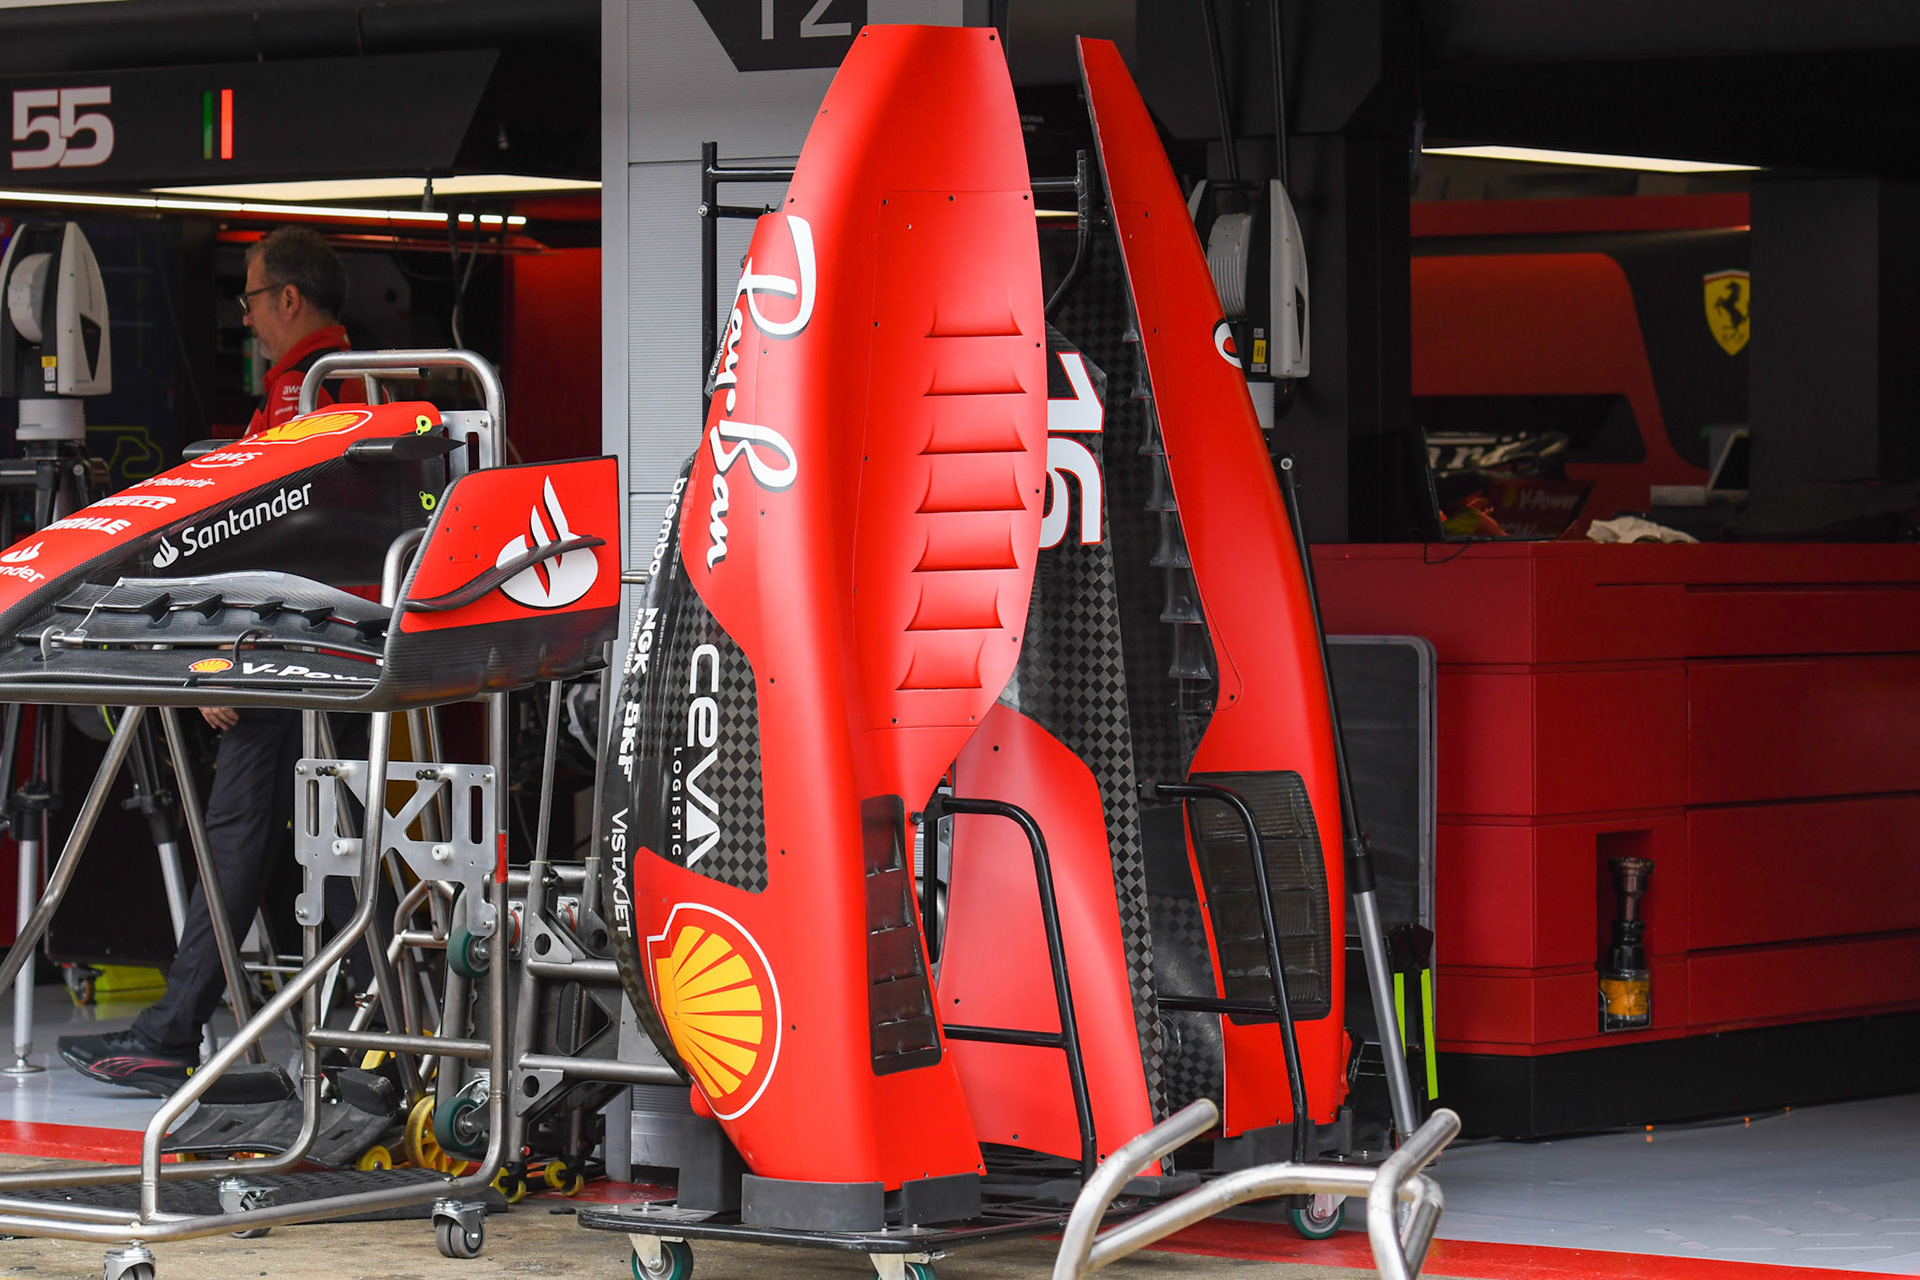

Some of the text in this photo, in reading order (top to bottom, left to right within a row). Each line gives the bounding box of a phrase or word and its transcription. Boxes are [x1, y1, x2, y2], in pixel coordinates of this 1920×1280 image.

[11, 86, 115, 169] 55
[282, 385, 301, 396] aw
[707, 215, 817, 570] Ray-Ban
[41, 517, 132, 535] MAHLE
[181, 483, 312, 557] Santander
[649, 477, 688, 575] brembo
[623, 608, 644, 674] SPARK PLUGS
[631, 607, 659, 674] NGK
[619, 701, 641, 782] SKF
[611, 807, 634, 938] VISTAJET
